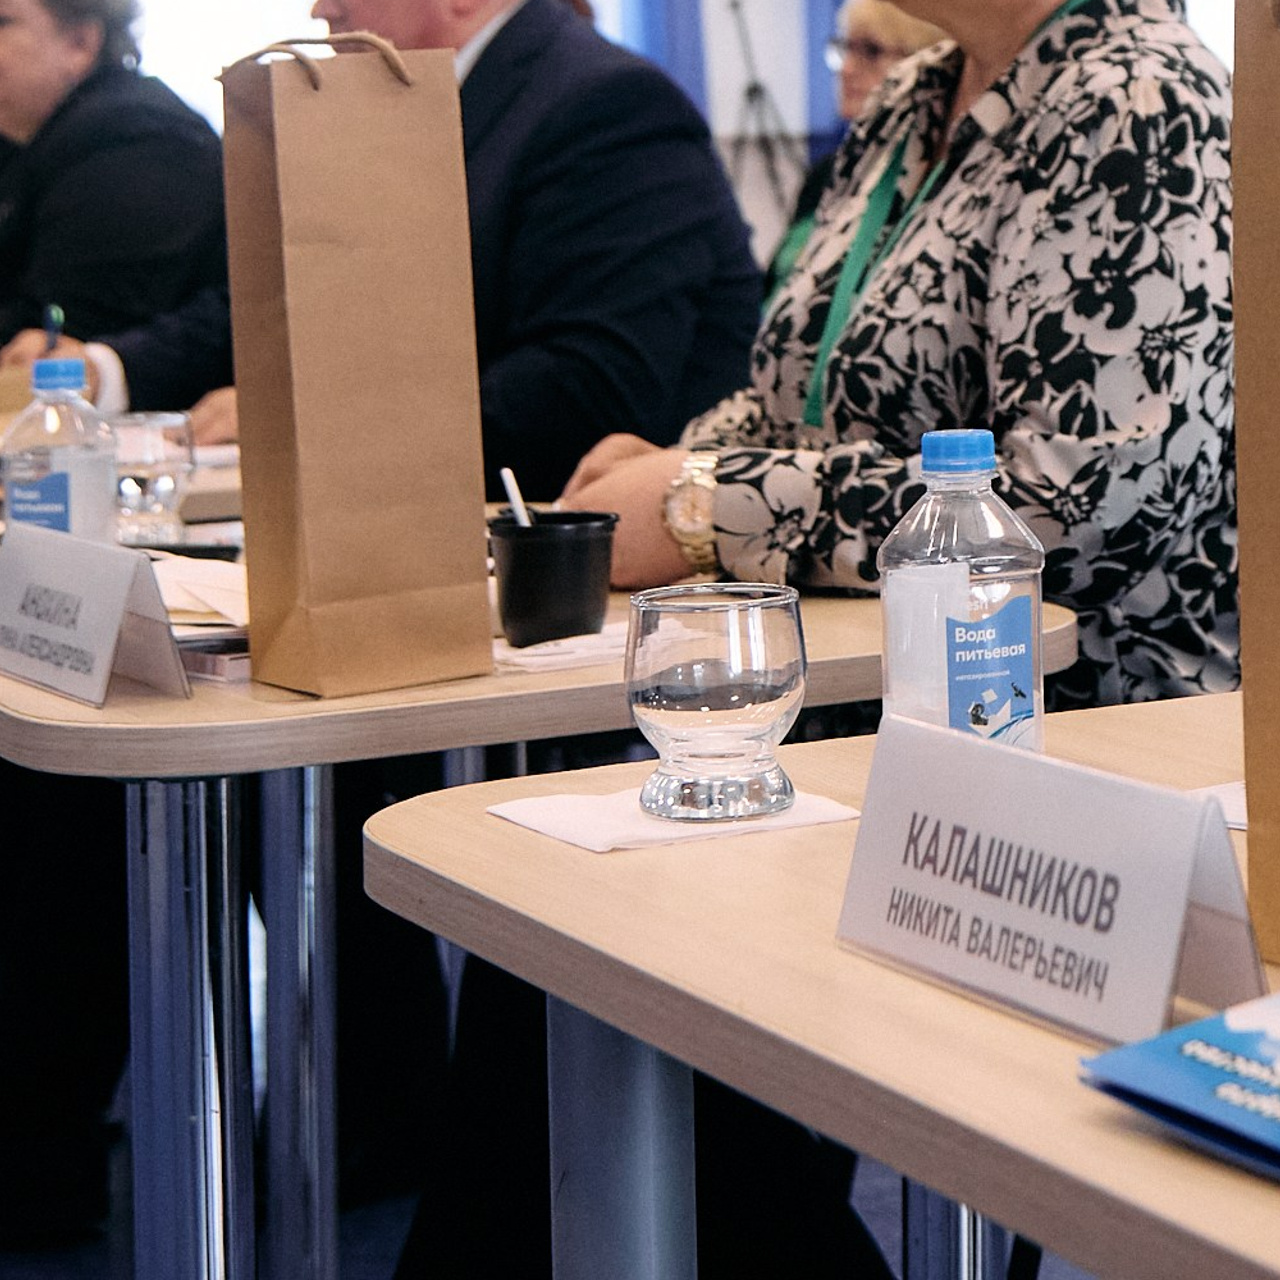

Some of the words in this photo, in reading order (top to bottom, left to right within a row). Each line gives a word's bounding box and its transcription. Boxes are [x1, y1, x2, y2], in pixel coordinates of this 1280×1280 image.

[955, 627, 996, 643] Вода
[955, 644, 1026, 662] питьевая
[902, 811, 1121, 934] КАЛАШНИКОВ
[886, 886, 963, 948] НИКИТА
[966, 918, 1110, 1002] ВАЛЕРЬЕВИЧ
